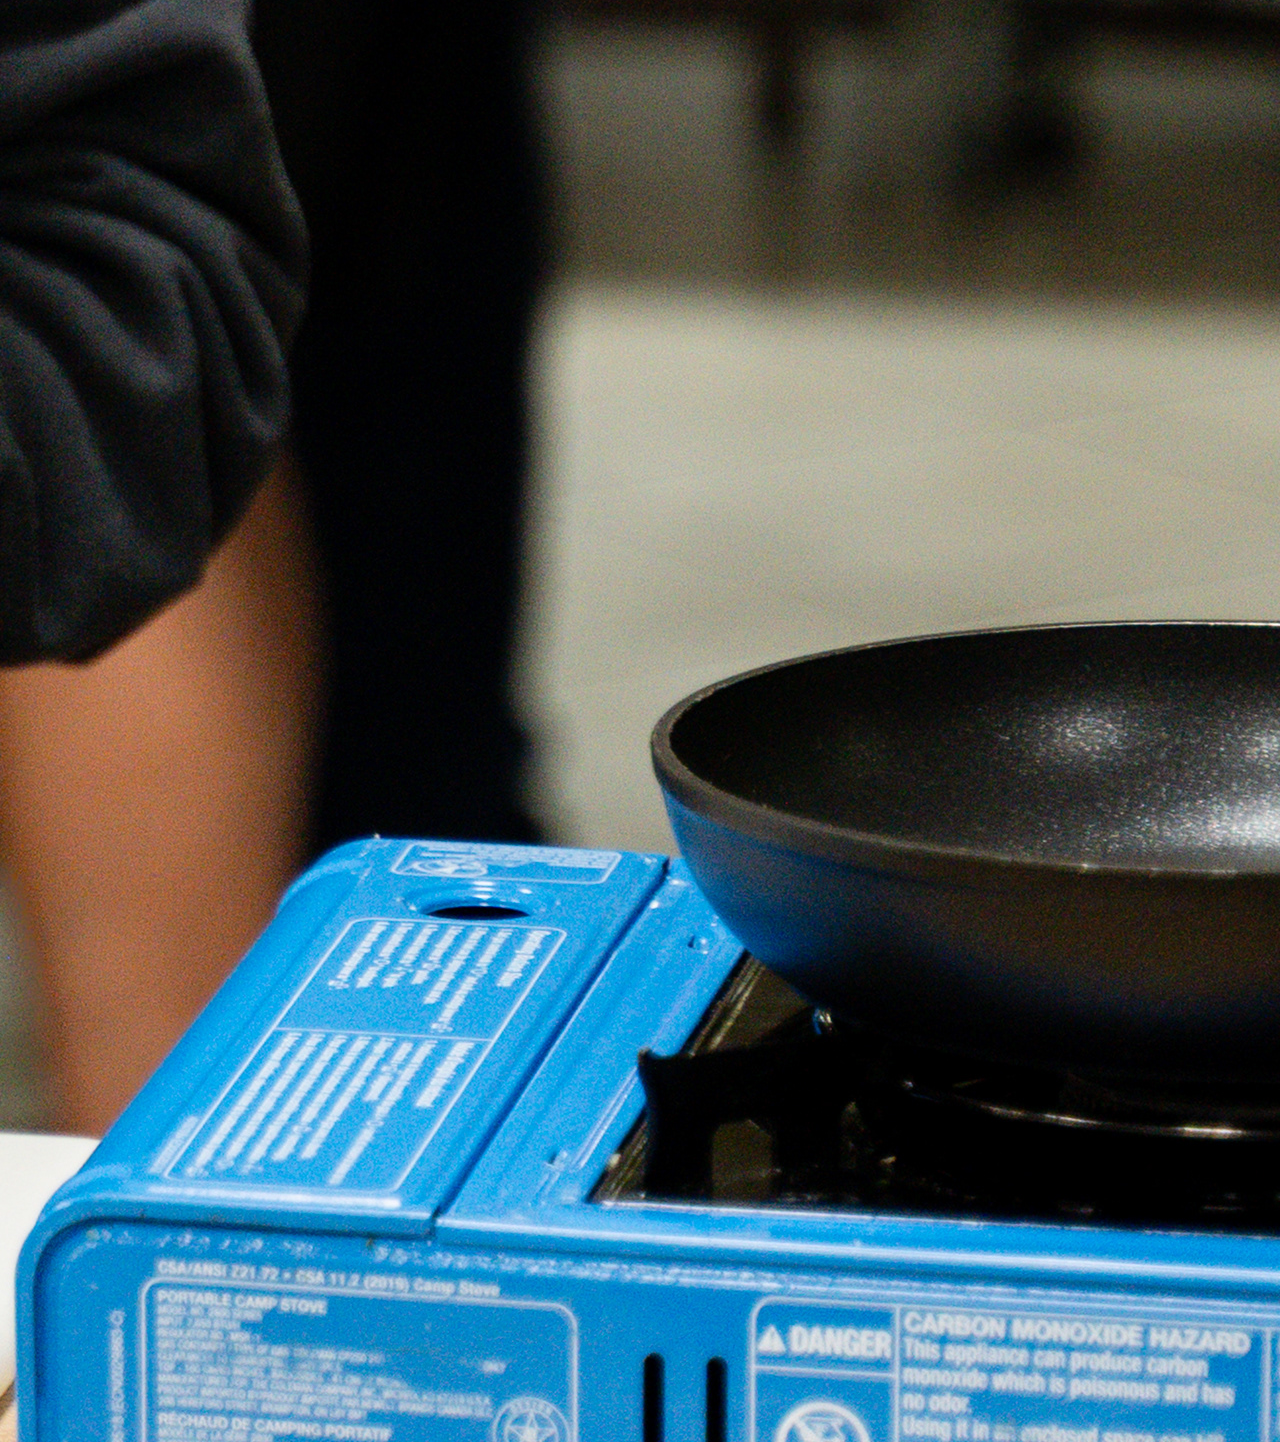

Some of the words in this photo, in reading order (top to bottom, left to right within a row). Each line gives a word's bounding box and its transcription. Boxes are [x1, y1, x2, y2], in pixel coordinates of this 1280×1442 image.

[157, 1289, 231, 1306] PORTABLE
[234, 1295, 278, 1309] CAMP
[280, 1298, 328, 1315] STOVE
[790, 1324, 892, 1359] DANGER
[904, 1312, 1006, 1338] CARBON
[1011, 1318, 1144, 1348] MONOXIDE
[1149, 1326, 1252, 1358] HAZARD
[904, 1336, 940, 1360] This
[944, 1343, 1030, 1367] appliance
[1034, 1350, 1066, 1368] can
[1070, 1350, 1142, 1374] produce
[1147, 1355, 1209, 1377] carbon
[903, 1367, 989, 1390] monoxide
[992, 1371, 1046, 1393] which
[1049, 1374, 1066, 1394] is
[1070, 1378, 1160, 1401] poisonous
[1163, 1382, 1199, 1404] and
[903, 1394, 925, 1410] no
[929, 1392, 972, 1414] odor.
[254, 1419, 322, 1436] CAMPING
[903, 1416, 951, 1442] Using
[972, 1420, 989, 1441] in
